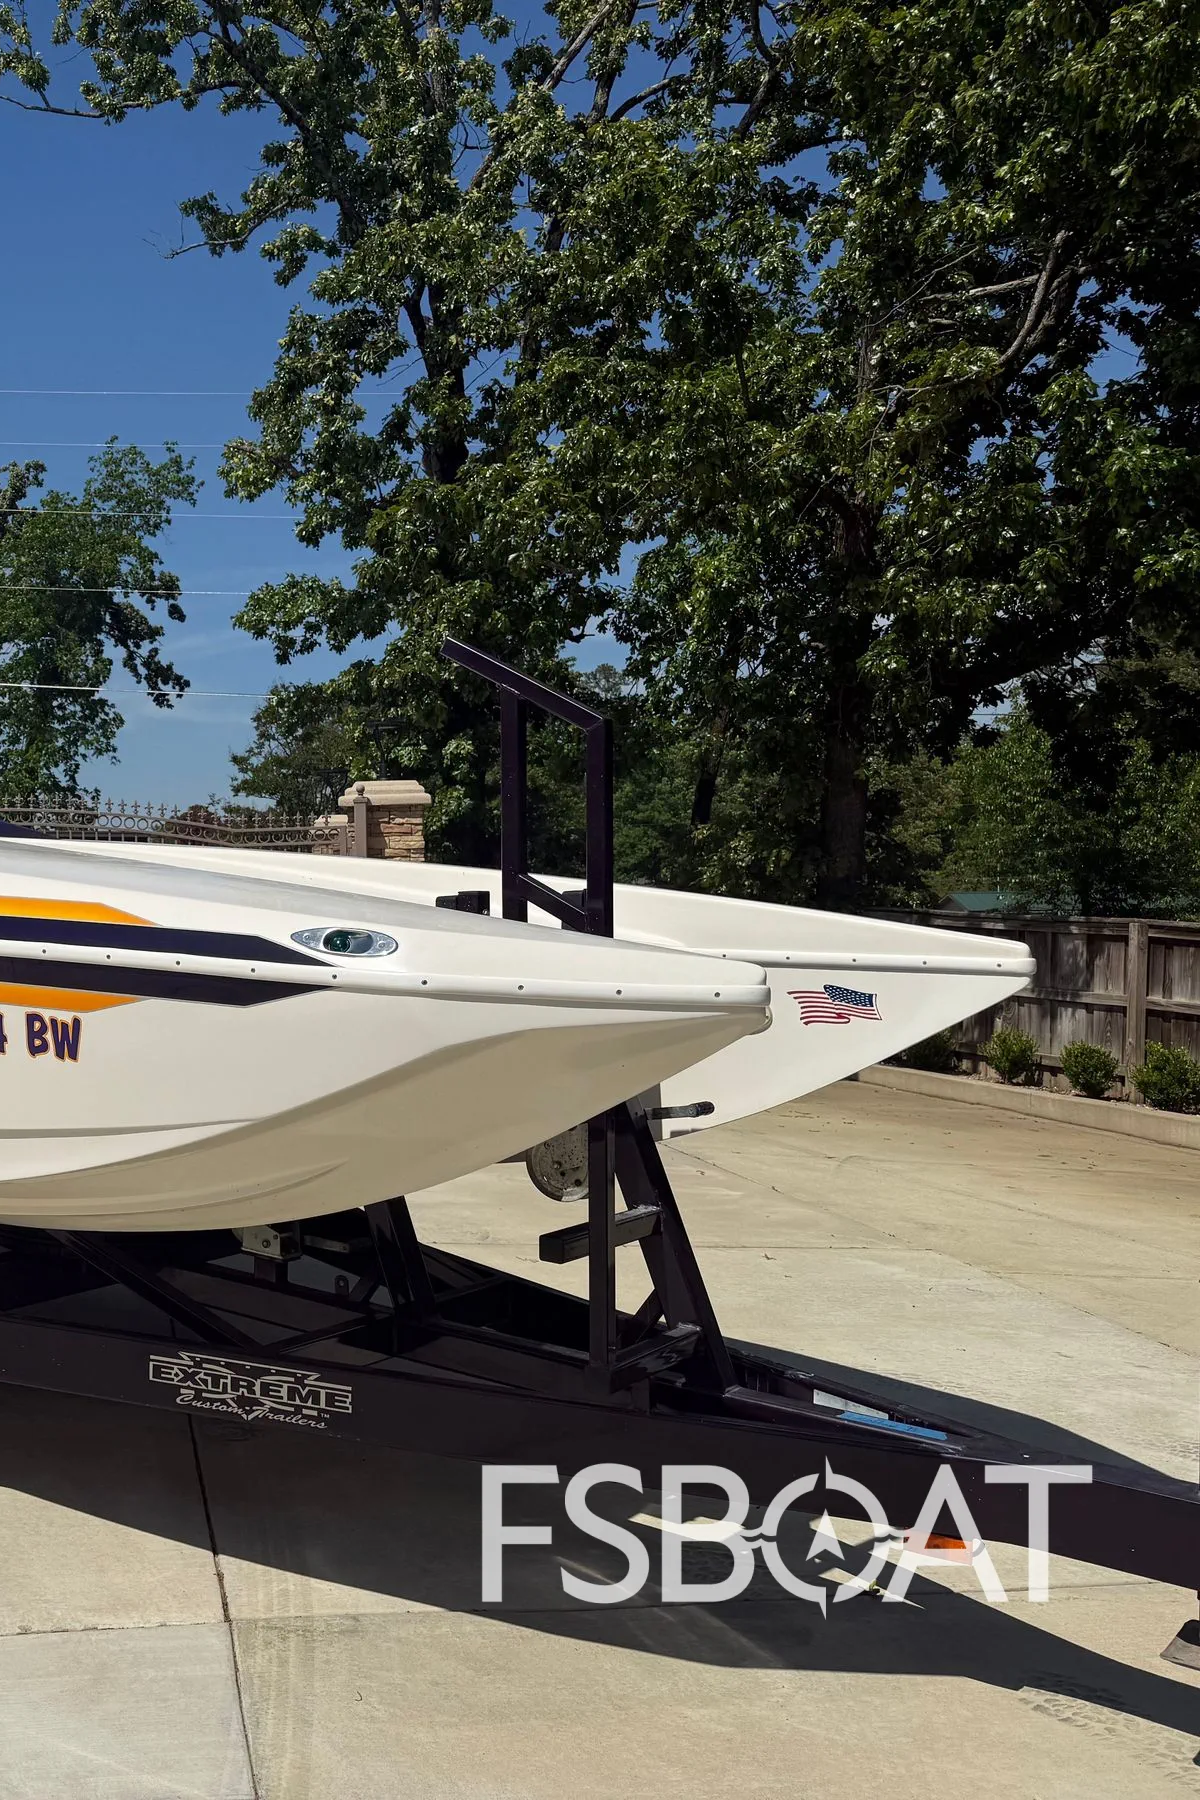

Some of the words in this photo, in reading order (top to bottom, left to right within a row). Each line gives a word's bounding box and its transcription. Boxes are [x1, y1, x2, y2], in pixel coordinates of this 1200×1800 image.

[25, 1010, 82, 1063] BW
[149, 1361, 352, 1414] EXTREME
[175, 1394, 245, 1415] Custom
[252, 1405, 328, 1430] Trailers
